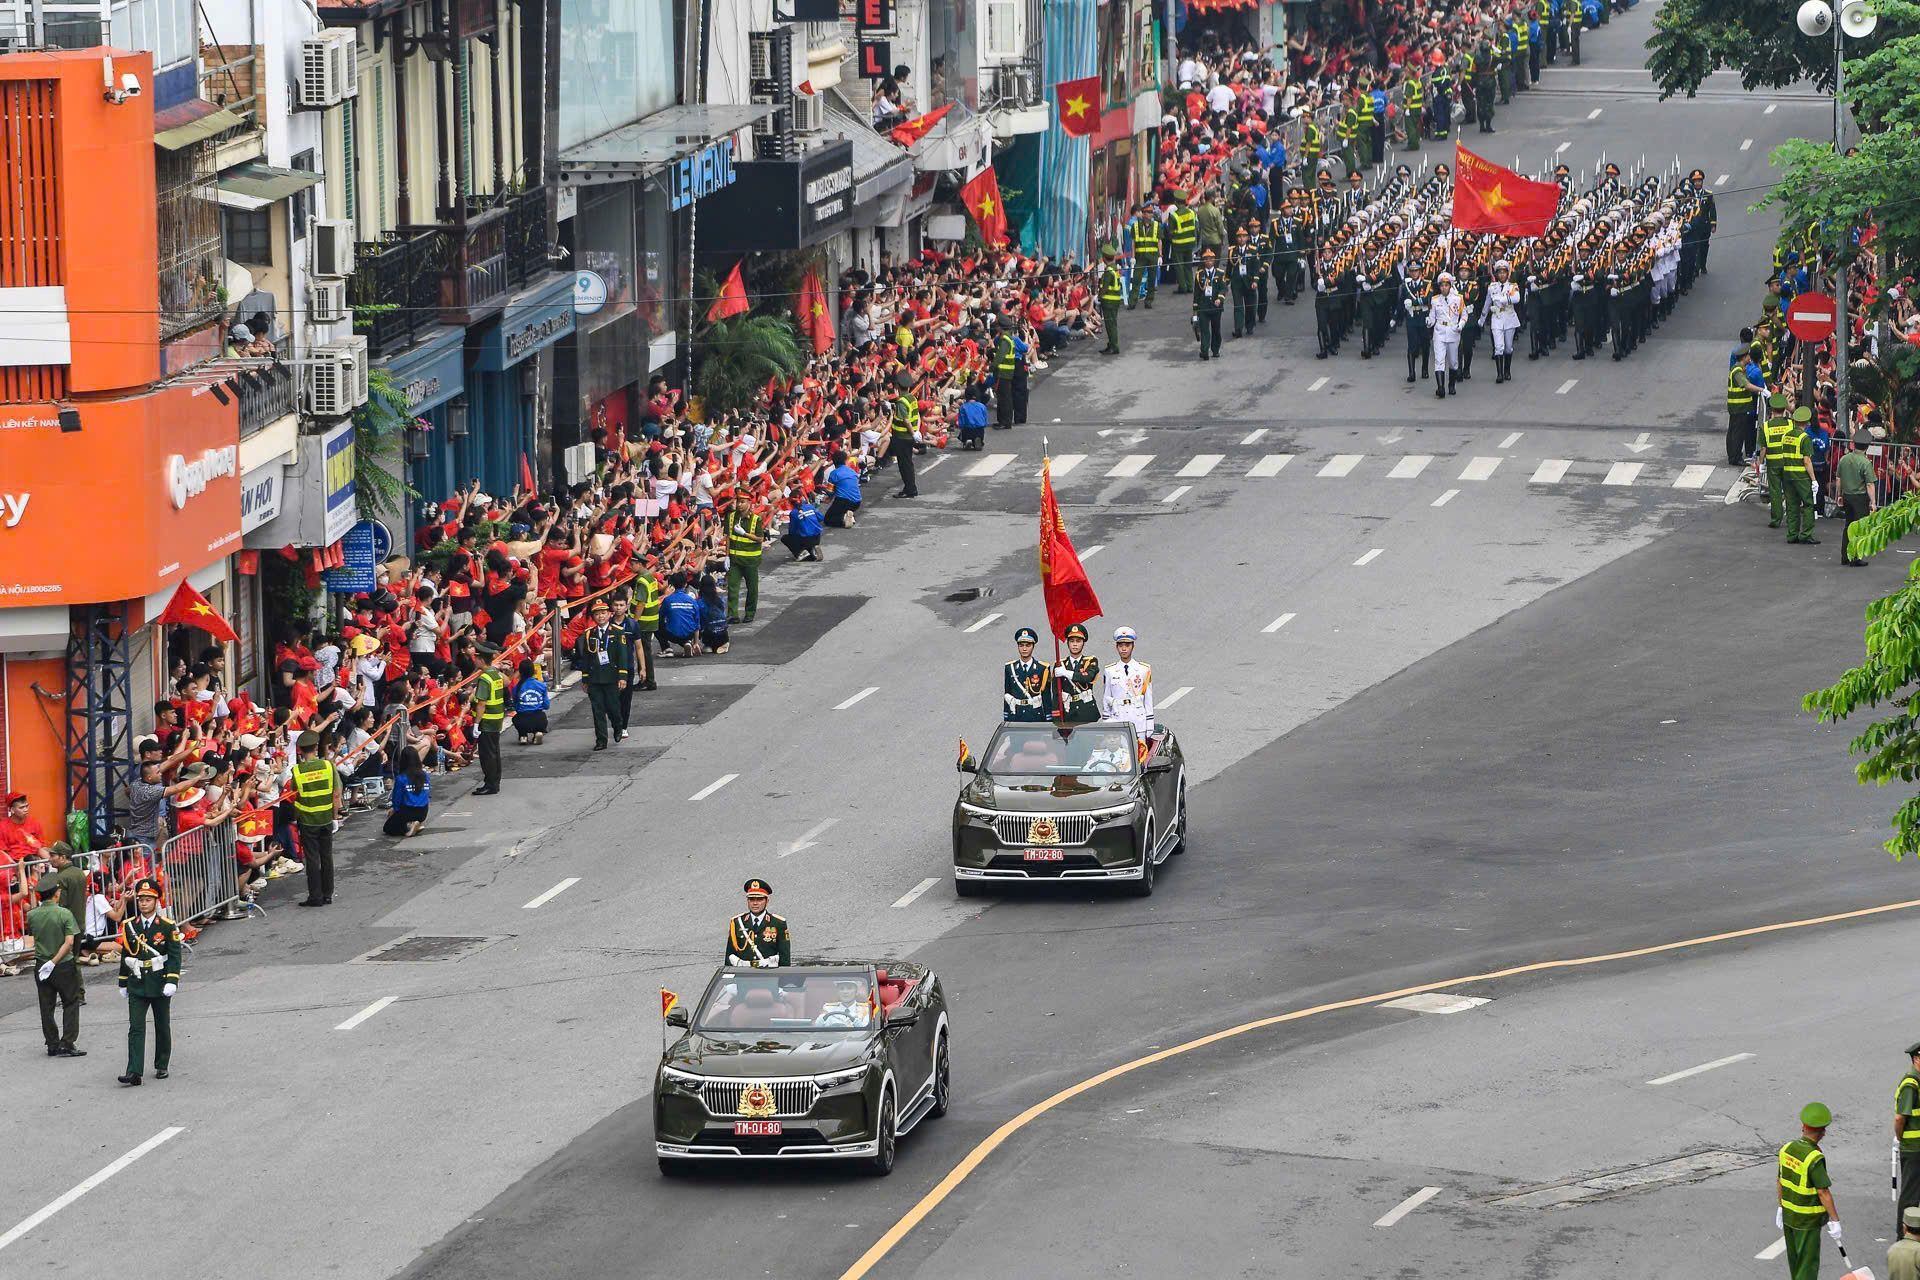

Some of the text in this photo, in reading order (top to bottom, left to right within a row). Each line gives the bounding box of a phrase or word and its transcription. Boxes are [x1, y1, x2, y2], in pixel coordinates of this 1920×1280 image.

[671, 136, 737, 212] LEMANIC
[21, 415, 39, 428] KẾT
[1024, 849, 1064, 860] TM-02-80
[735, 1121, 781, 1135] TM-01-80
